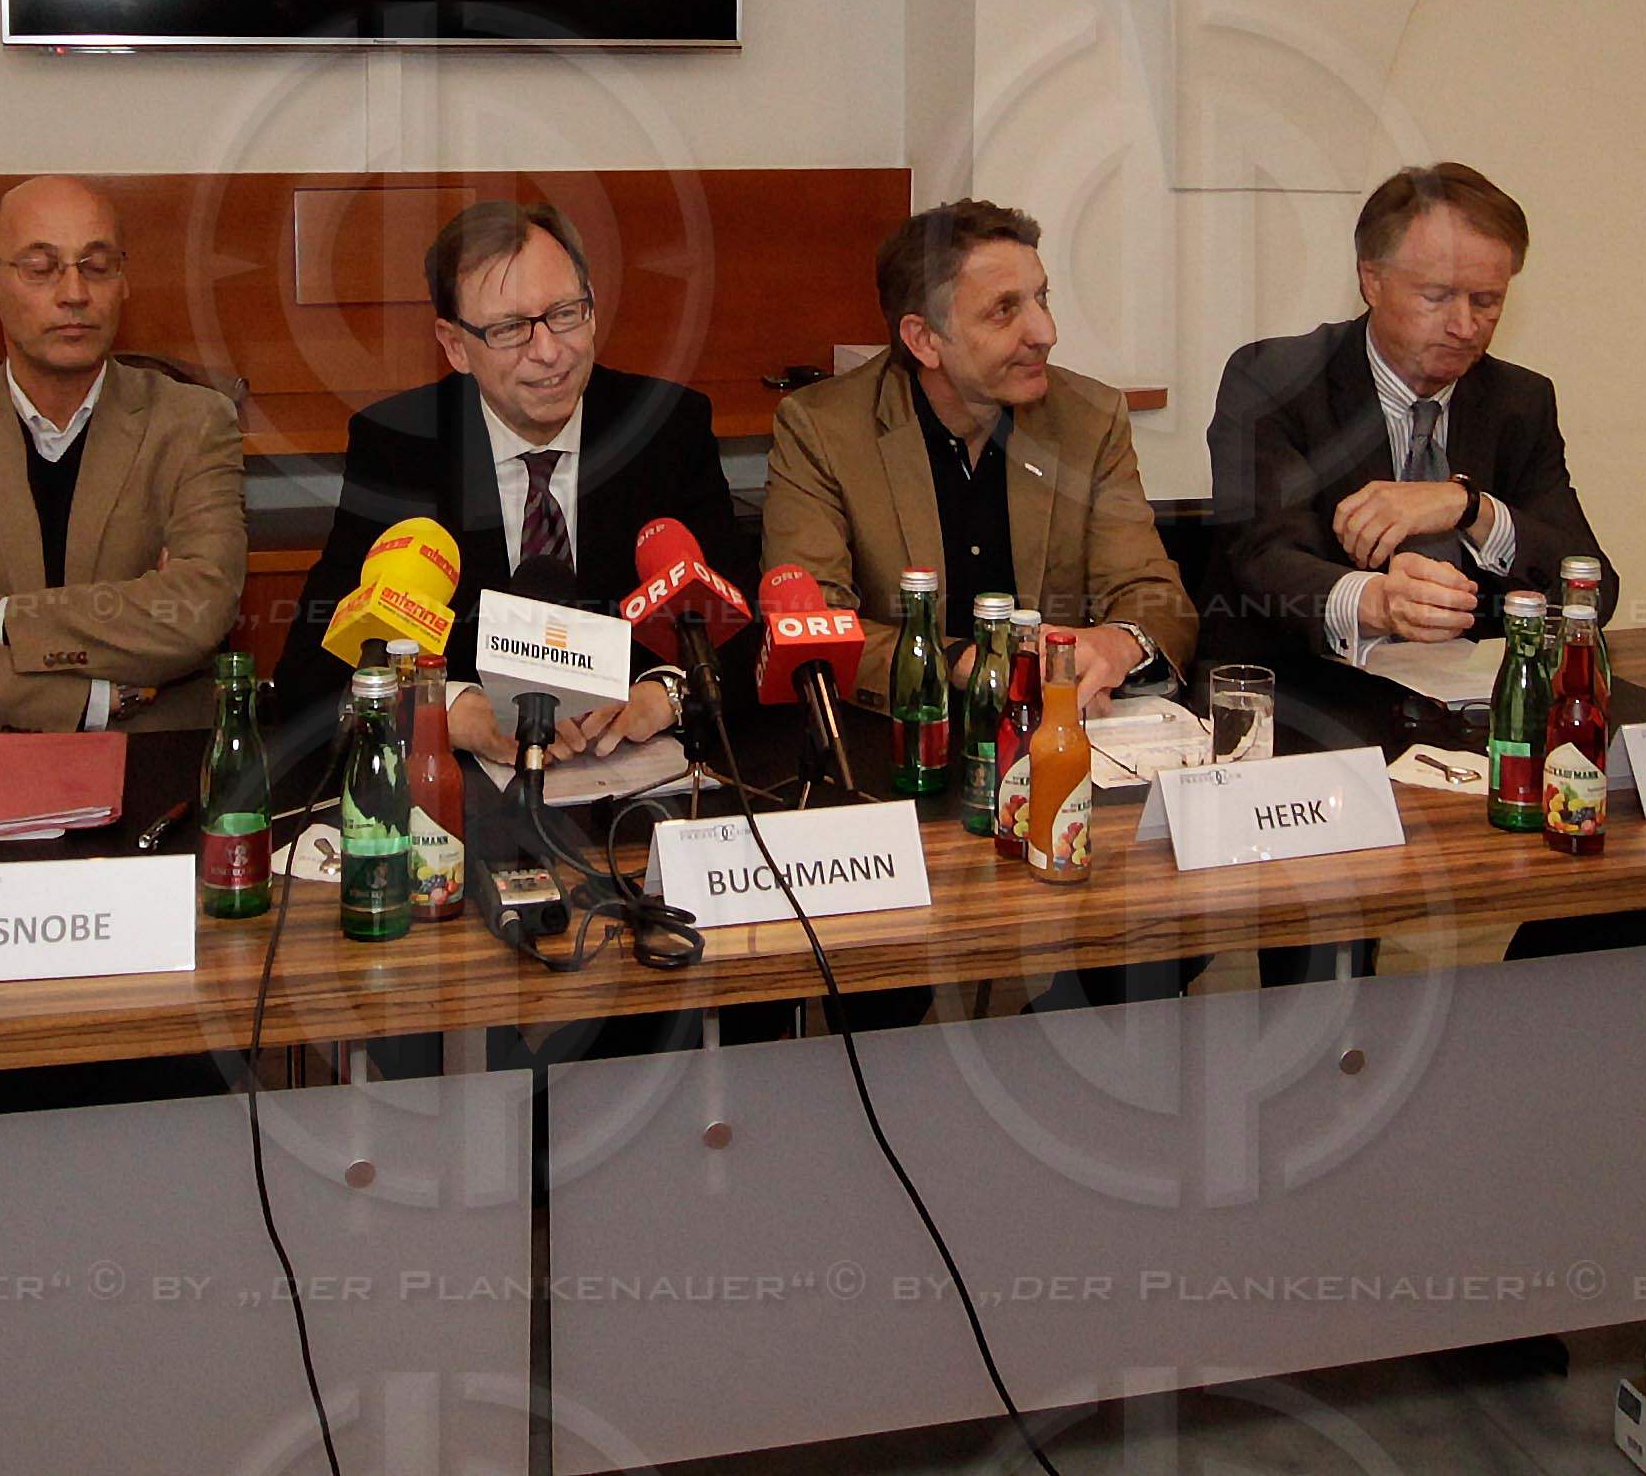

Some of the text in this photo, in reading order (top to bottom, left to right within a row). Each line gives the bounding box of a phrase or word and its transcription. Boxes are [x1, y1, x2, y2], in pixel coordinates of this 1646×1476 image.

[626, 561, 687, 620] ORF
[693, 561, 746, 605] ORF
[381, 587, 449, 632] antenne
[778, 615, 854, 638] ORF
[490, 635, 595, 671] SOUNDPORTAL
[1255, 800, 1328, 830] HERK
[707, 853, 896, 897] BUCHMANN
